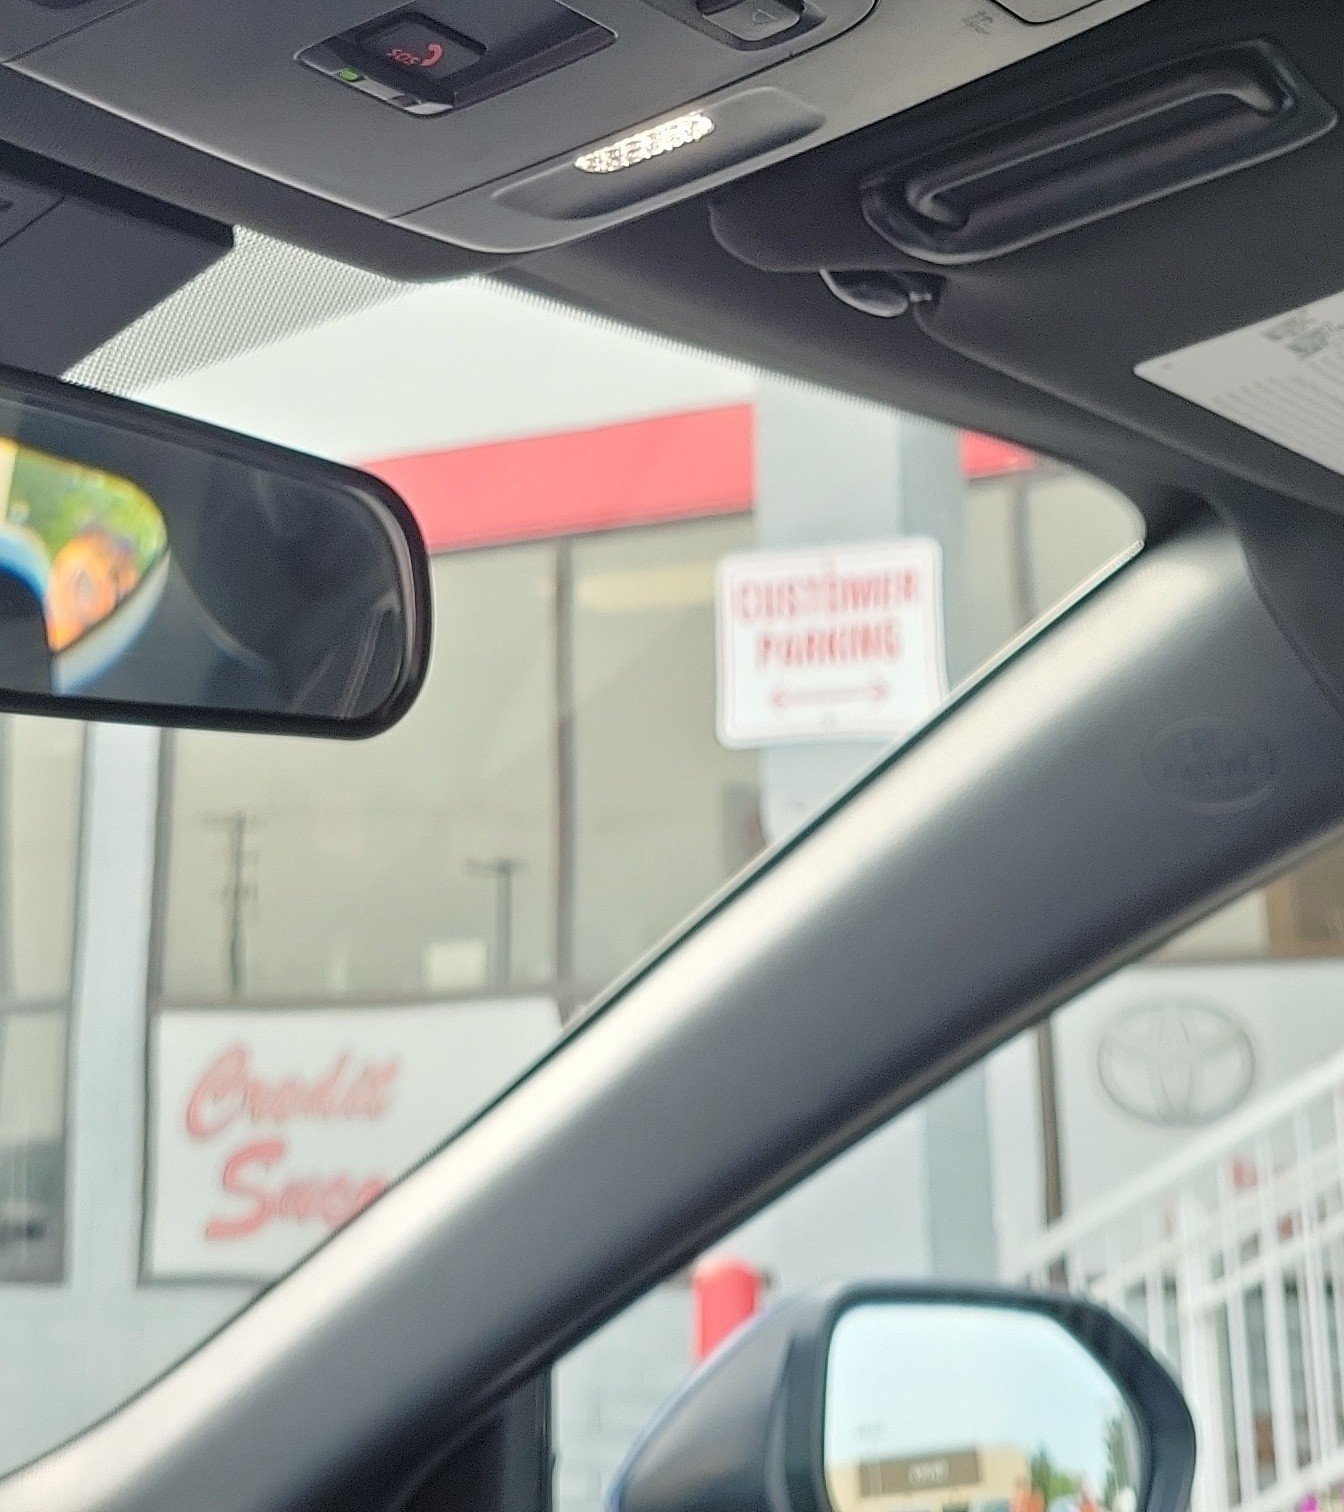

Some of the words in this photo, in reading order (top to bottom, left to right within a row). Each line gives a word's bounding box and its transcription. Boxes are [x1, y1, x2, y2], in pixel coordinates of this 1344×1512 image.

[731, 566, 919, 621] CUSTOMER
[757, 618, 901, 667] PARKING
[185, 1040, 403, 1143] Credit
